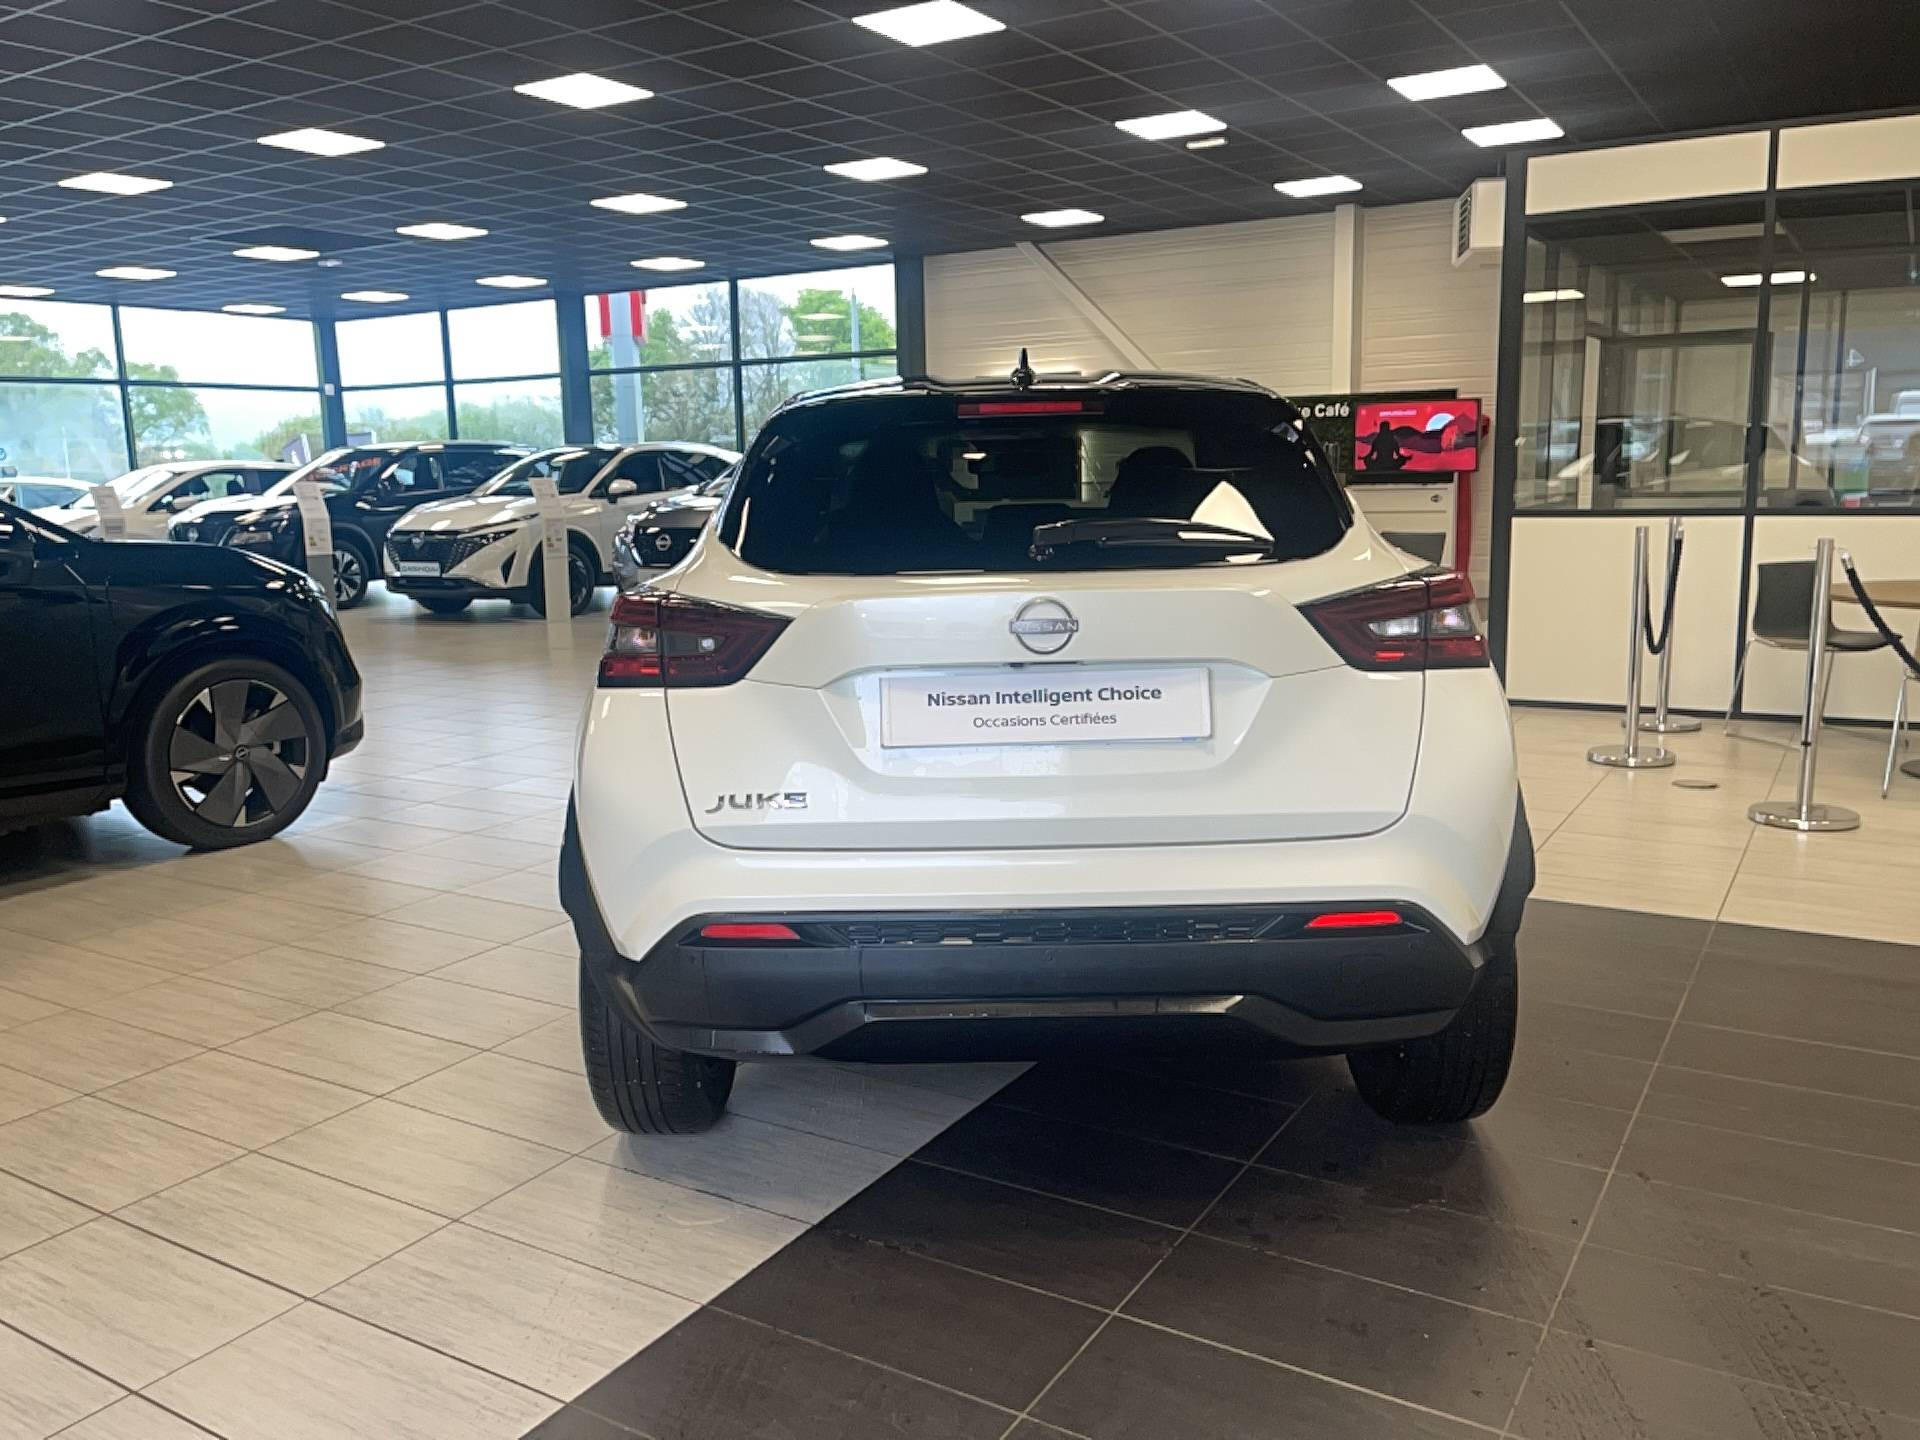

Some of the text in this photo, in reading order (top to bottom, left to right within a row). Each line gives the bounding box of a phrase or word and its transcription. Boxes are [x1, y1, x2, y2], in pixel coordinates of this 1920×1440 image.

[1314, 402, 1350, 418] Café
[1012, 621, 1078, 633] NISSAN
[927, 685, 1162, 707] Nissan Intelligent Choice
[973, 712, 1117, 728] Occasions Certifiées
[704, 791, 808, 814] JUKE
